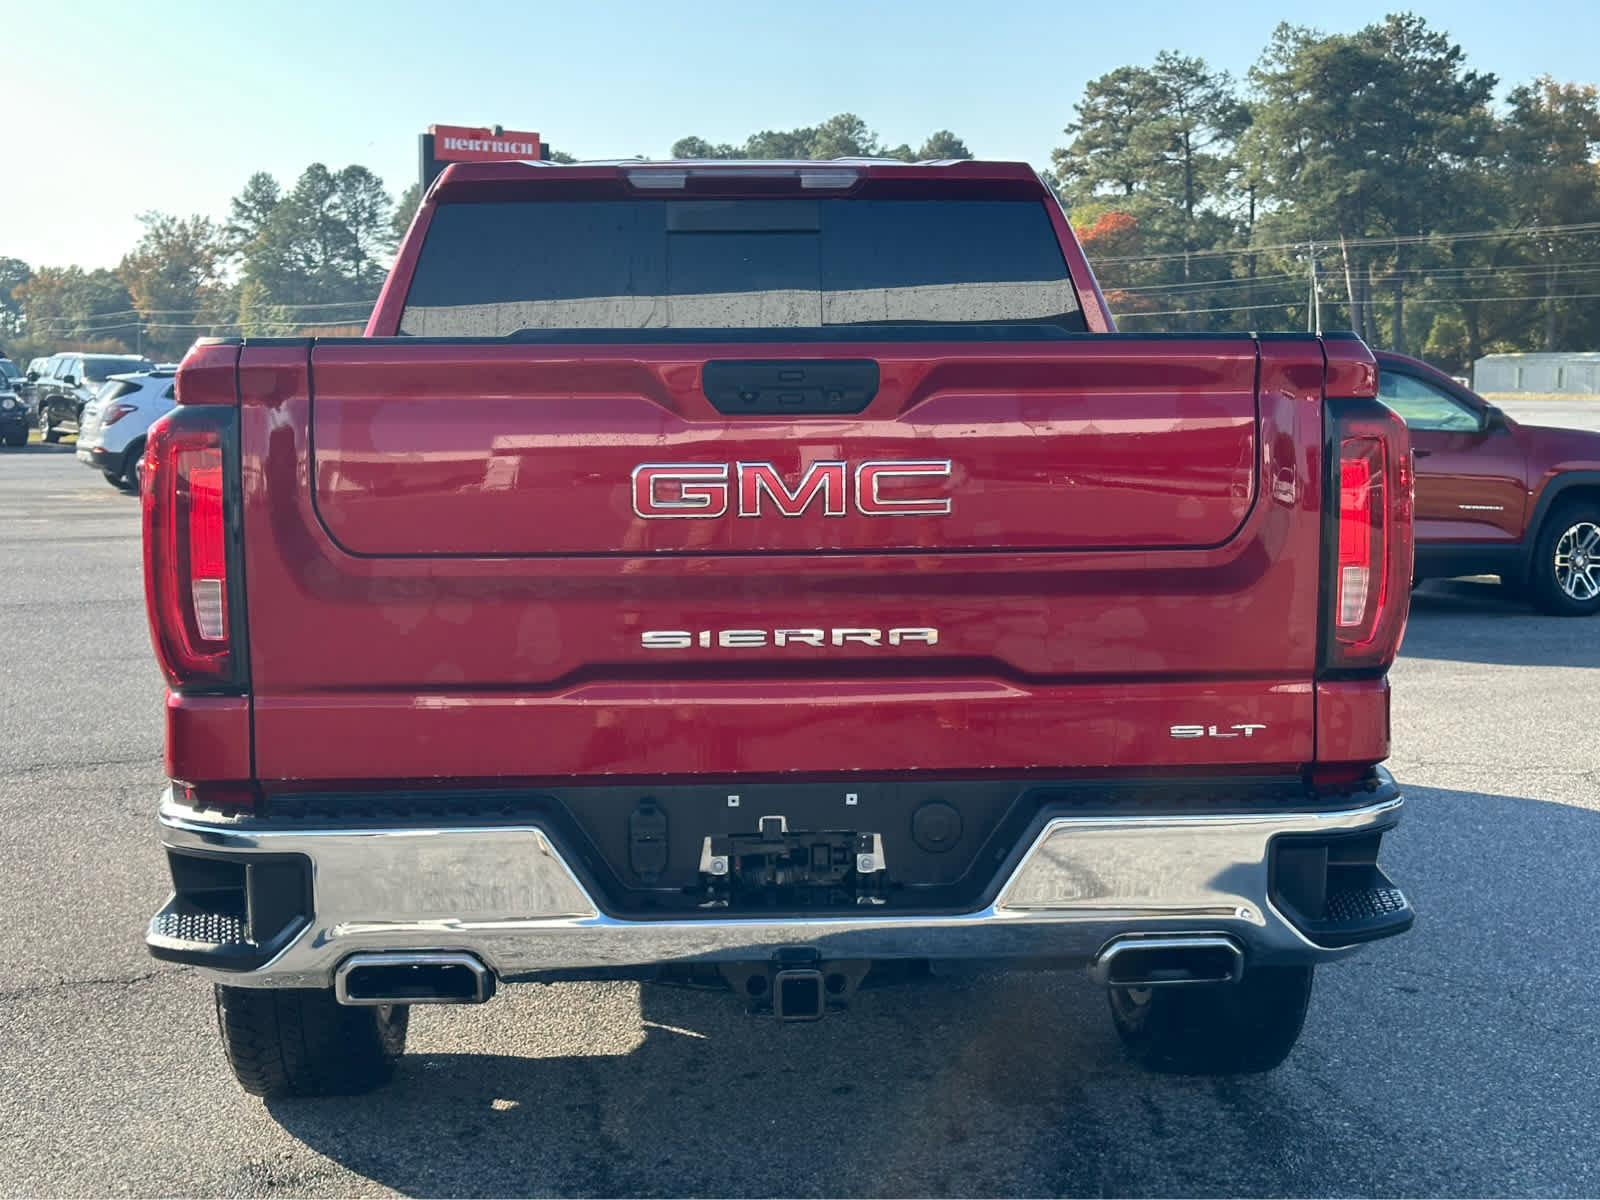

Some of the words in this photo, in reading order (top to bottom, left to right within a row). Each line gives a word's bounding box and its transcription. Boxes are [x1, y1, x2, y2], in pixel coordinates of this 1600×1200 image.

[631, 460, 952, 518] GMC
[641, 628, 938, 648] SIERRA
[1170, 724, 1266, 737] SLT
